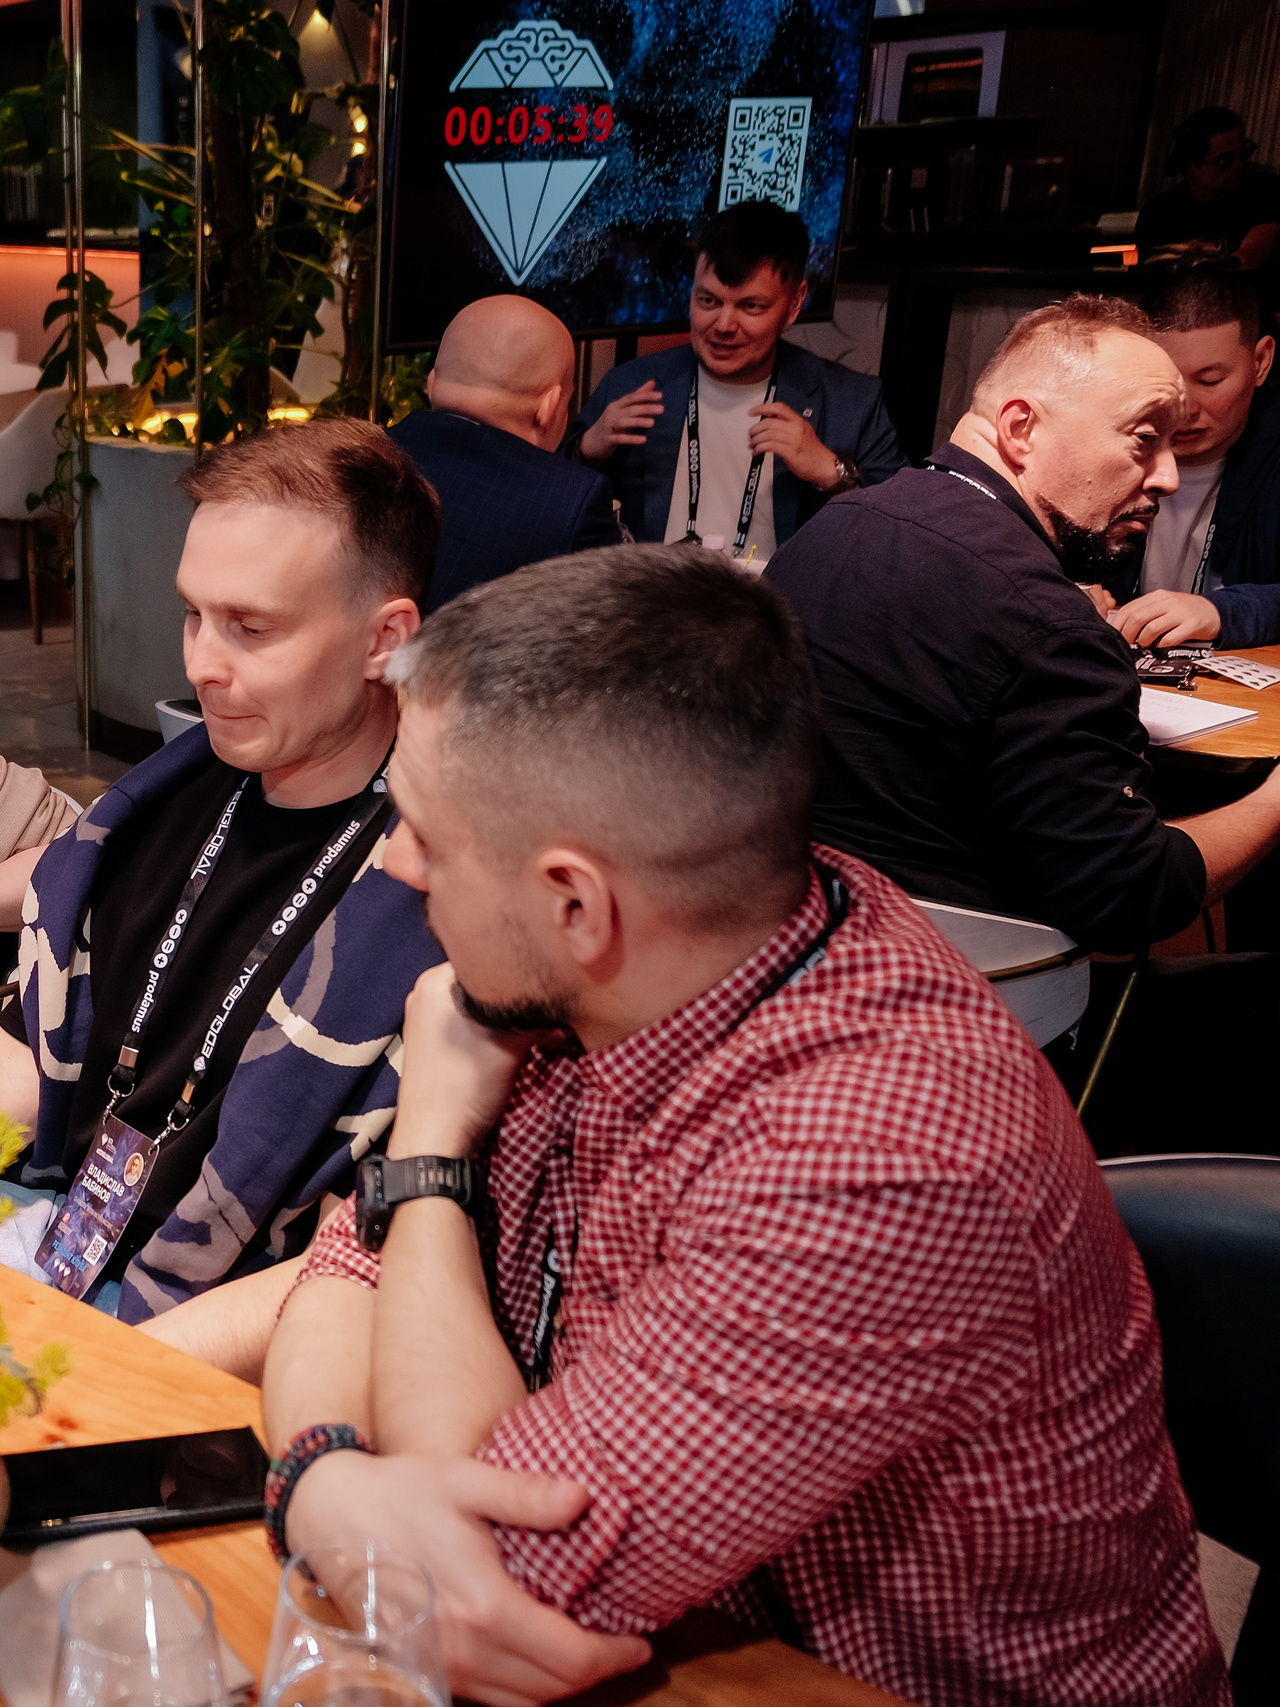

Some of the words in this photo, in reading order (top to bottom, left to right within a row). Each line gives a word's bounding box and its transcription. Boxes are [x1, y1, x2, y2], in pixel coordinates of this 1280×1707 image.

[444, 103, 615, 147] 00:05:39
[190, 789, 244, 880] EDGLOBAL
[313, 820, 361, 878] prodamus
[131, 970, 160, 1034] prodamus
[201, 963, 260, 1059] EDGLOBAL
[81, 1174, 111, 1204] БАБИНОВ
[86, 1163, 125, 1197] ВЛАДИСЛАВ
